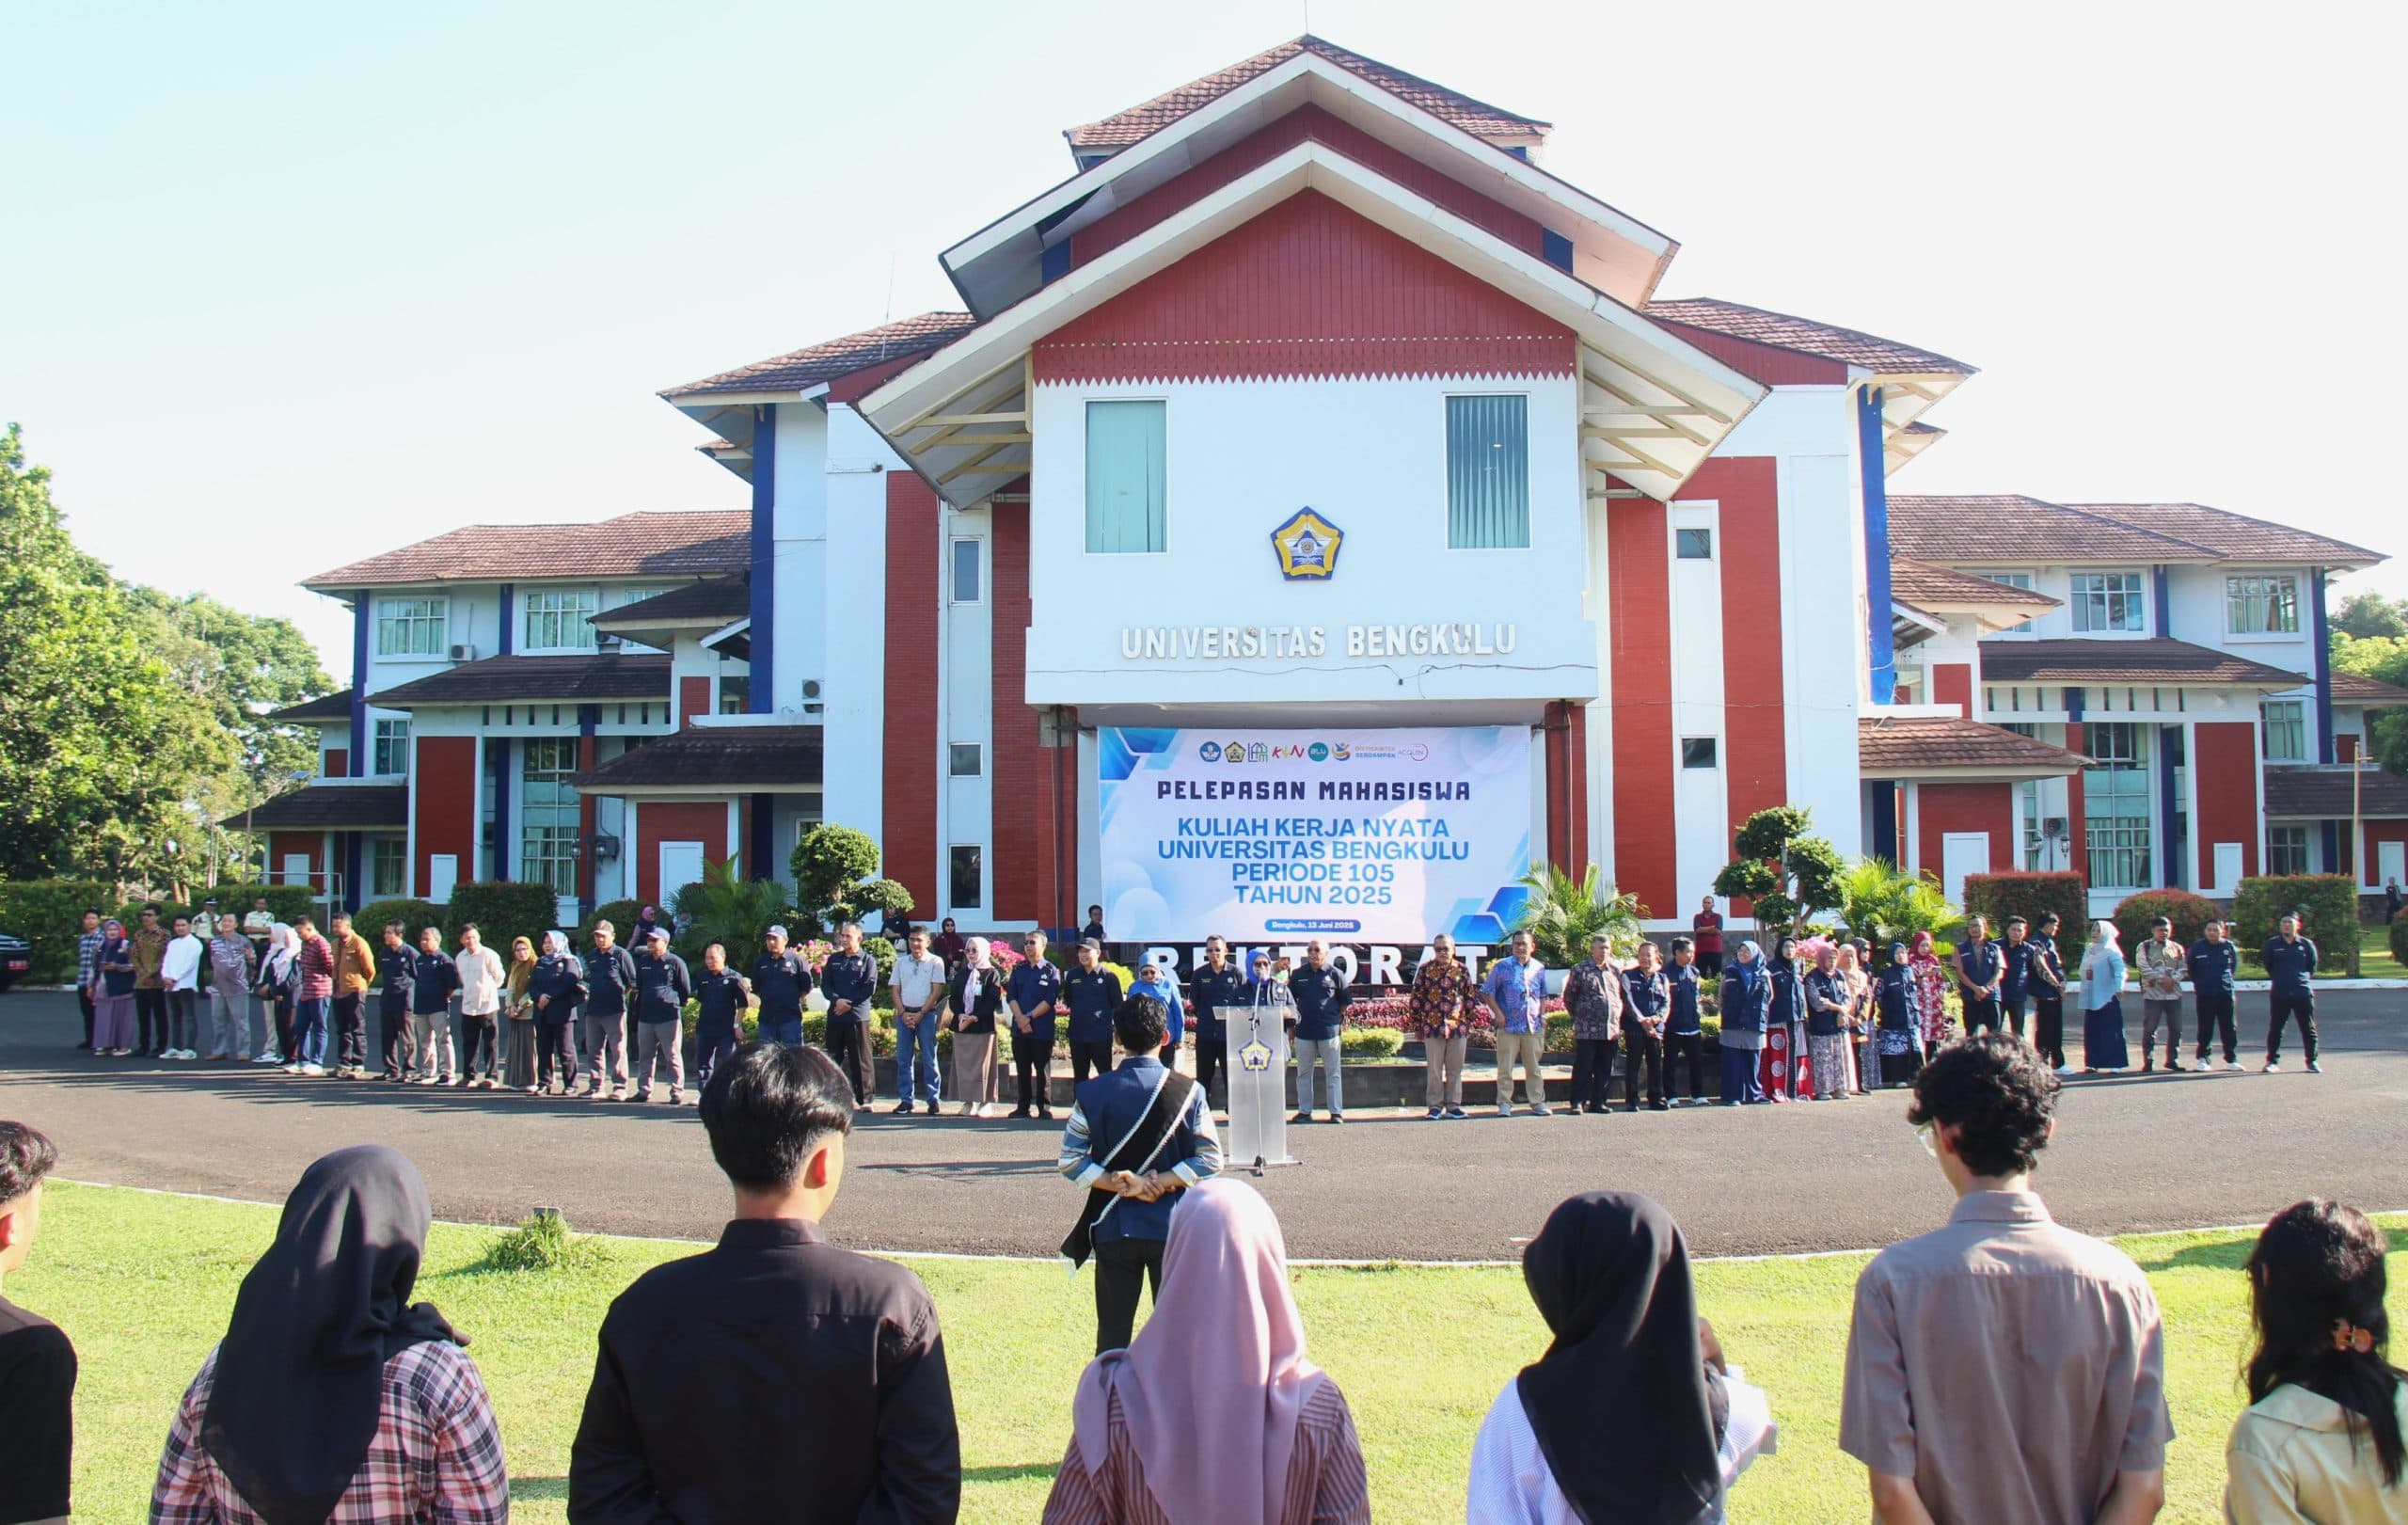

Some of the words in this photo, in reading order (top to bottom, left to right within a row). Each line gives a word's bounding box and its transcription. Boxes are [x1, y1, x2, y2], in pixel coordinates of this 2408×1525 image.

[1121, 625, 1325, 659] UNIVERSITAS
[1347, 624, 1516, 657] BENGKULU
[1157, 781, 1306, 800] PELEPASAN
[1319, 781, 1470, 801] MAHASISWA
[1178, 818, 1269, 836] KULIAH
[1275, 818, 1355, 837] KERJA
[1363, 818, 1450, 837] NYATA
[1158, 840, 1325, 859] UNIVERSITAS
[1332, 840, 1469, 860] BENGKULU
[1232, 863, 1342, 882] PERIODE
[1348, 863, 1394, 882] 105
[1233, 885, 1322, 904] TAHUN
[1328, 885, 1392, 905] 2025
[1272, 921, 1307, 929] Bengkulu,
